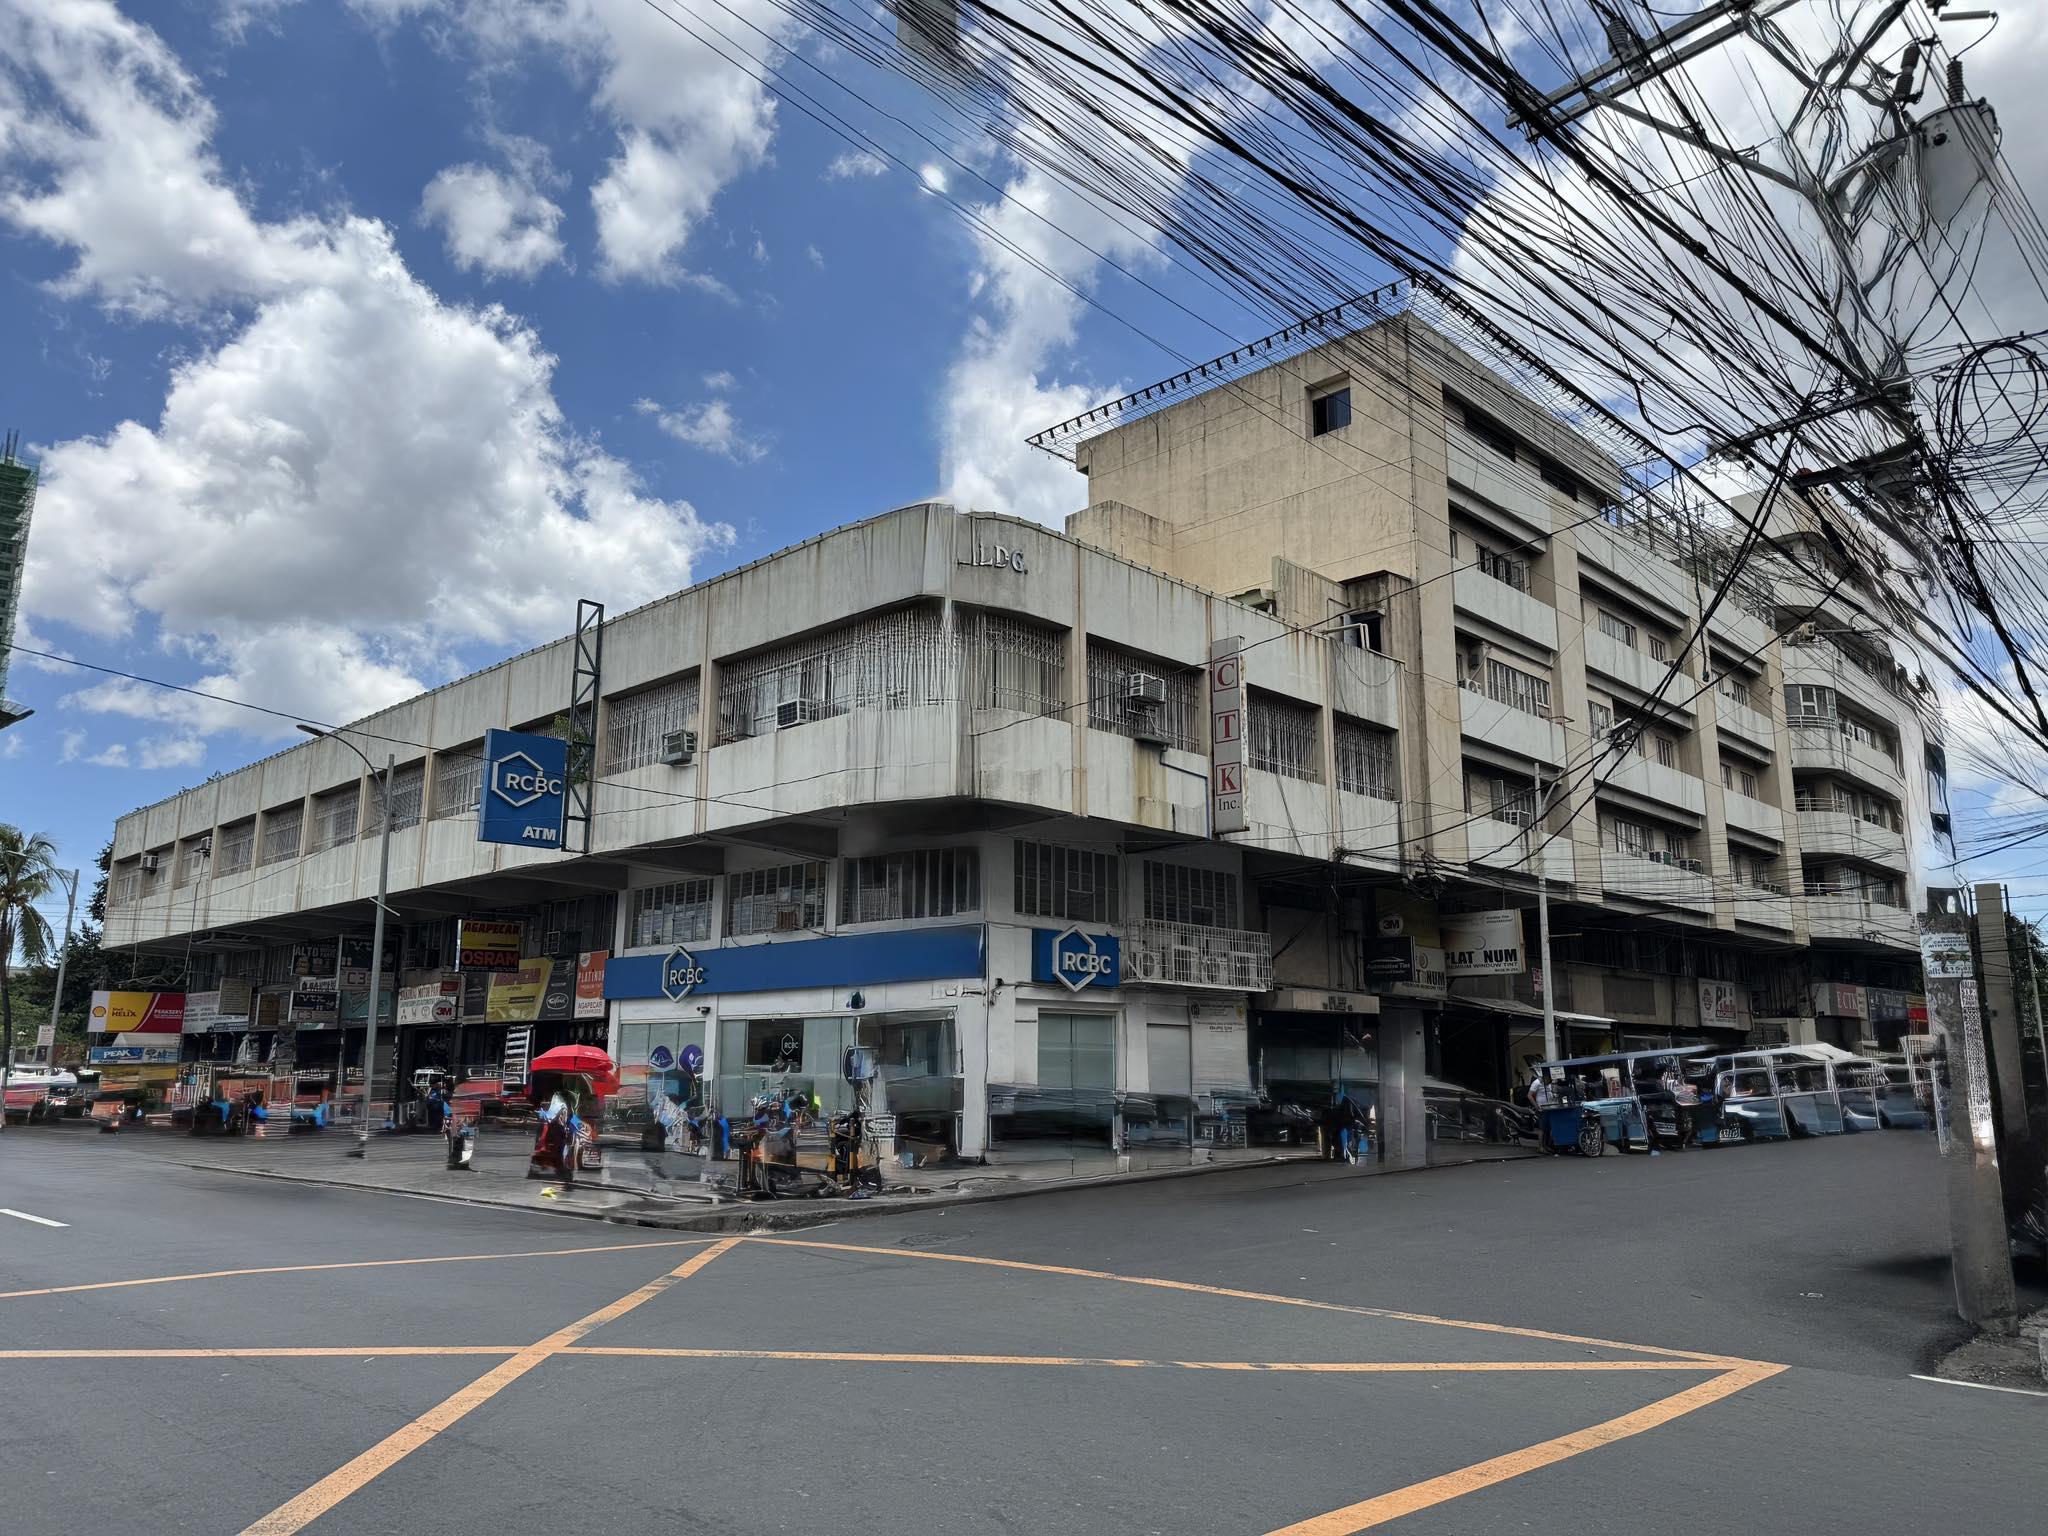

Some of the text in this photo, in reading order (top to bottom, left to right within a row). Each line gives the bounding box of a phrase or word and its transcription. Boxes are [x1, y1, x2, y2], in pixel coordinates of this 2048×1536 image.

[505, 772, 561, 795] RCBC
[1218, 798, 1241, 811] Inc.
[522, 826, 556, 840] ATM
[1383, 919, 1400, 930] 3M
[295, 946, 319, 957] ALTO
[461, 950, 518, 967] OSRAM
[1062, 951, 1112, 974] RCBC
[669, 967, 704, 985] RCBC
[436, 1007, 452, 1015] 3M
[103, 1049, 132, 1058] PEAK
